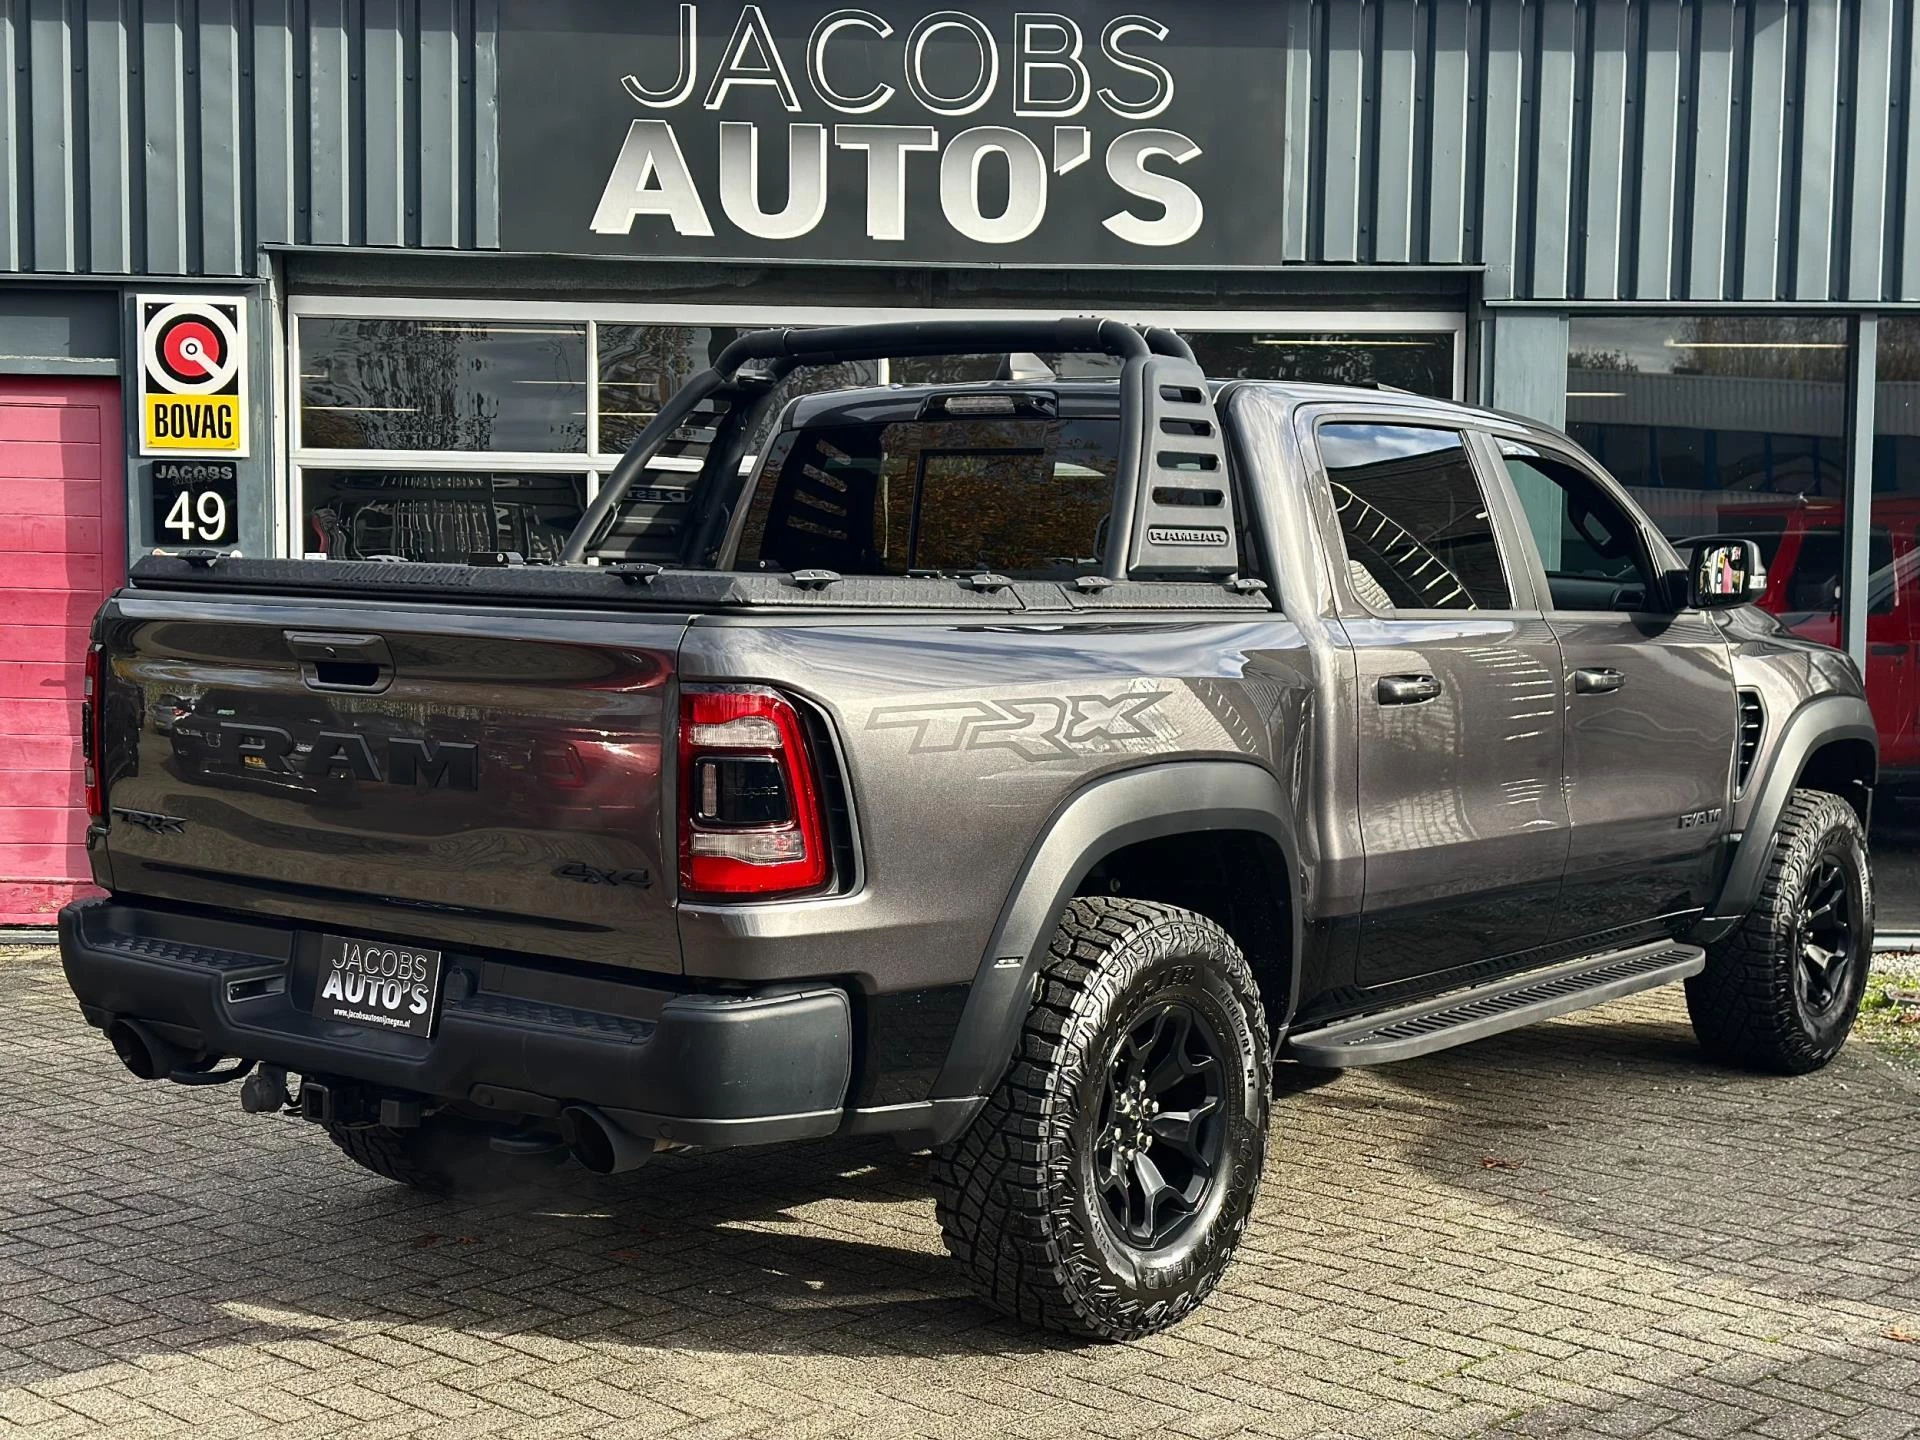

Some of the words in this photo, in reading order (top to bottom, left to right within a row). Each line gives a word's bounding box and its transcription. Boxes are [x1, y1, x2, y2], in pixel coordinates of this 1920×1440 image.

[620, 3, 1175, 120] JACOBS
[589, 118, 1204, 247] AUTO'S
[154, 403, 232, 439] BOVAG
[155, 465, 233, 480] JACOBS
[164, 490, 226, 541] 49
[1150, 531, 1225, 543] RAMBAR
[864, 690, 1174, 762] TRX
[220, 721, 479, 792] RAM
[111, 806, 188, 834] TRX
[332, 942, 428, 982] JACOBS
[321, 969, 430, 1015] AUTO'S
[1219, 986, 1252, 1057] TERRITORY
[1246, 1068, 1256, 1090] RT
